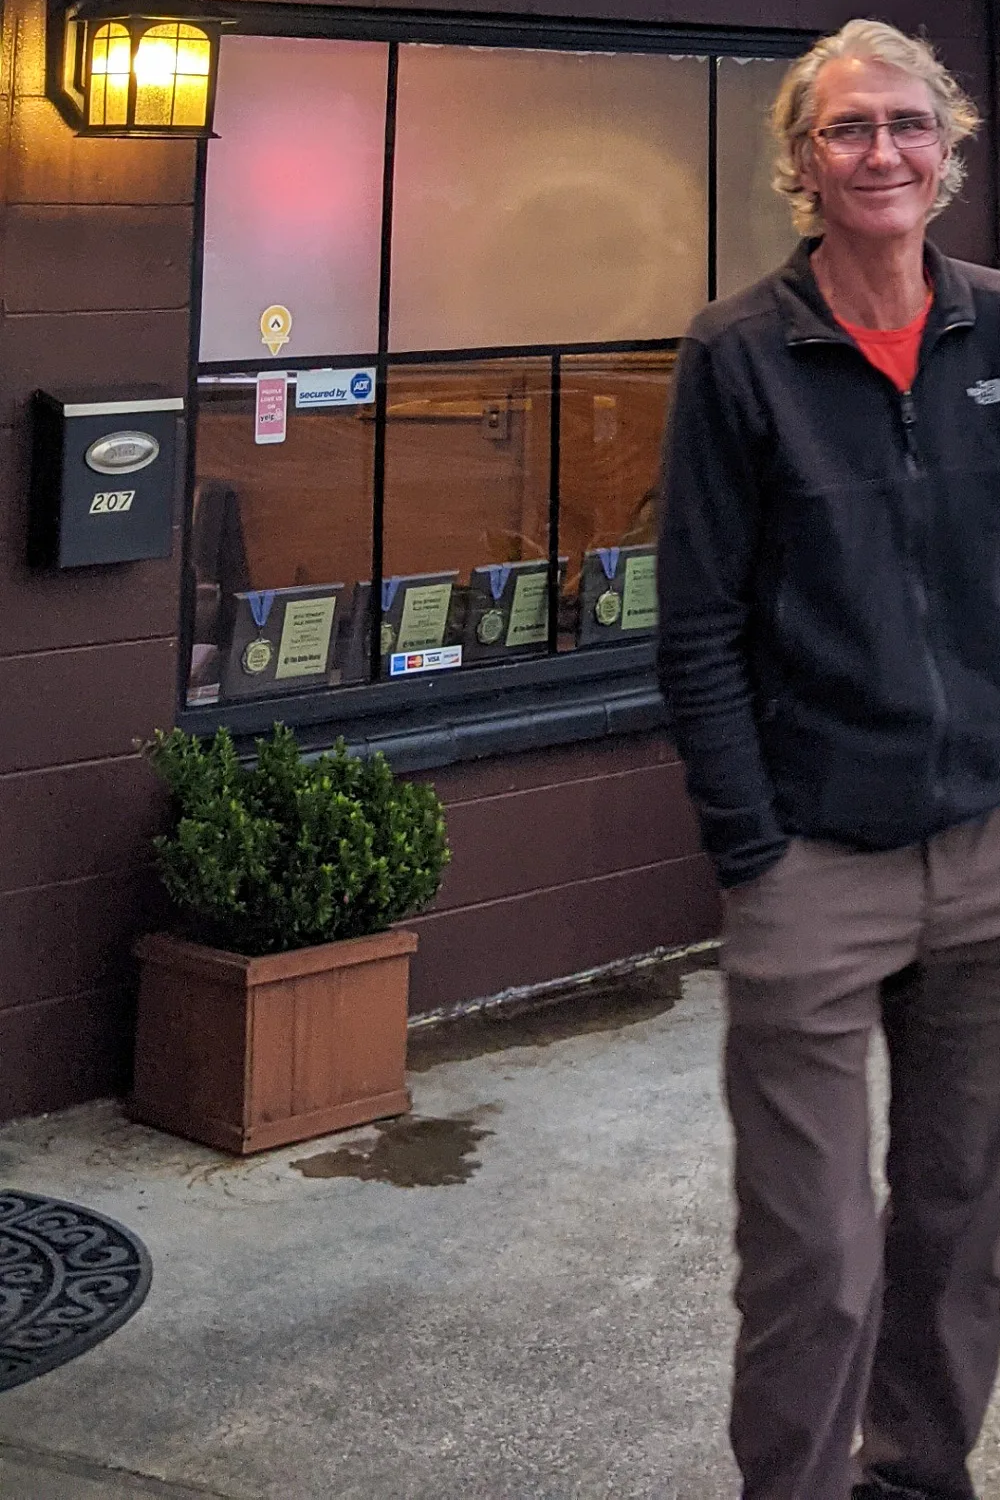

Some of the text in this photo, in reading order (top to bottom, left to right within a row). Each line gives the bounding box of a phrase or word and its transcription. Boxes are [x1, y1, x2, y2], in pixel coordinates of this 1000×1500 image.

[299, 379, 370, 400] secured by ADT
[92, 492, 133, 511] 207
